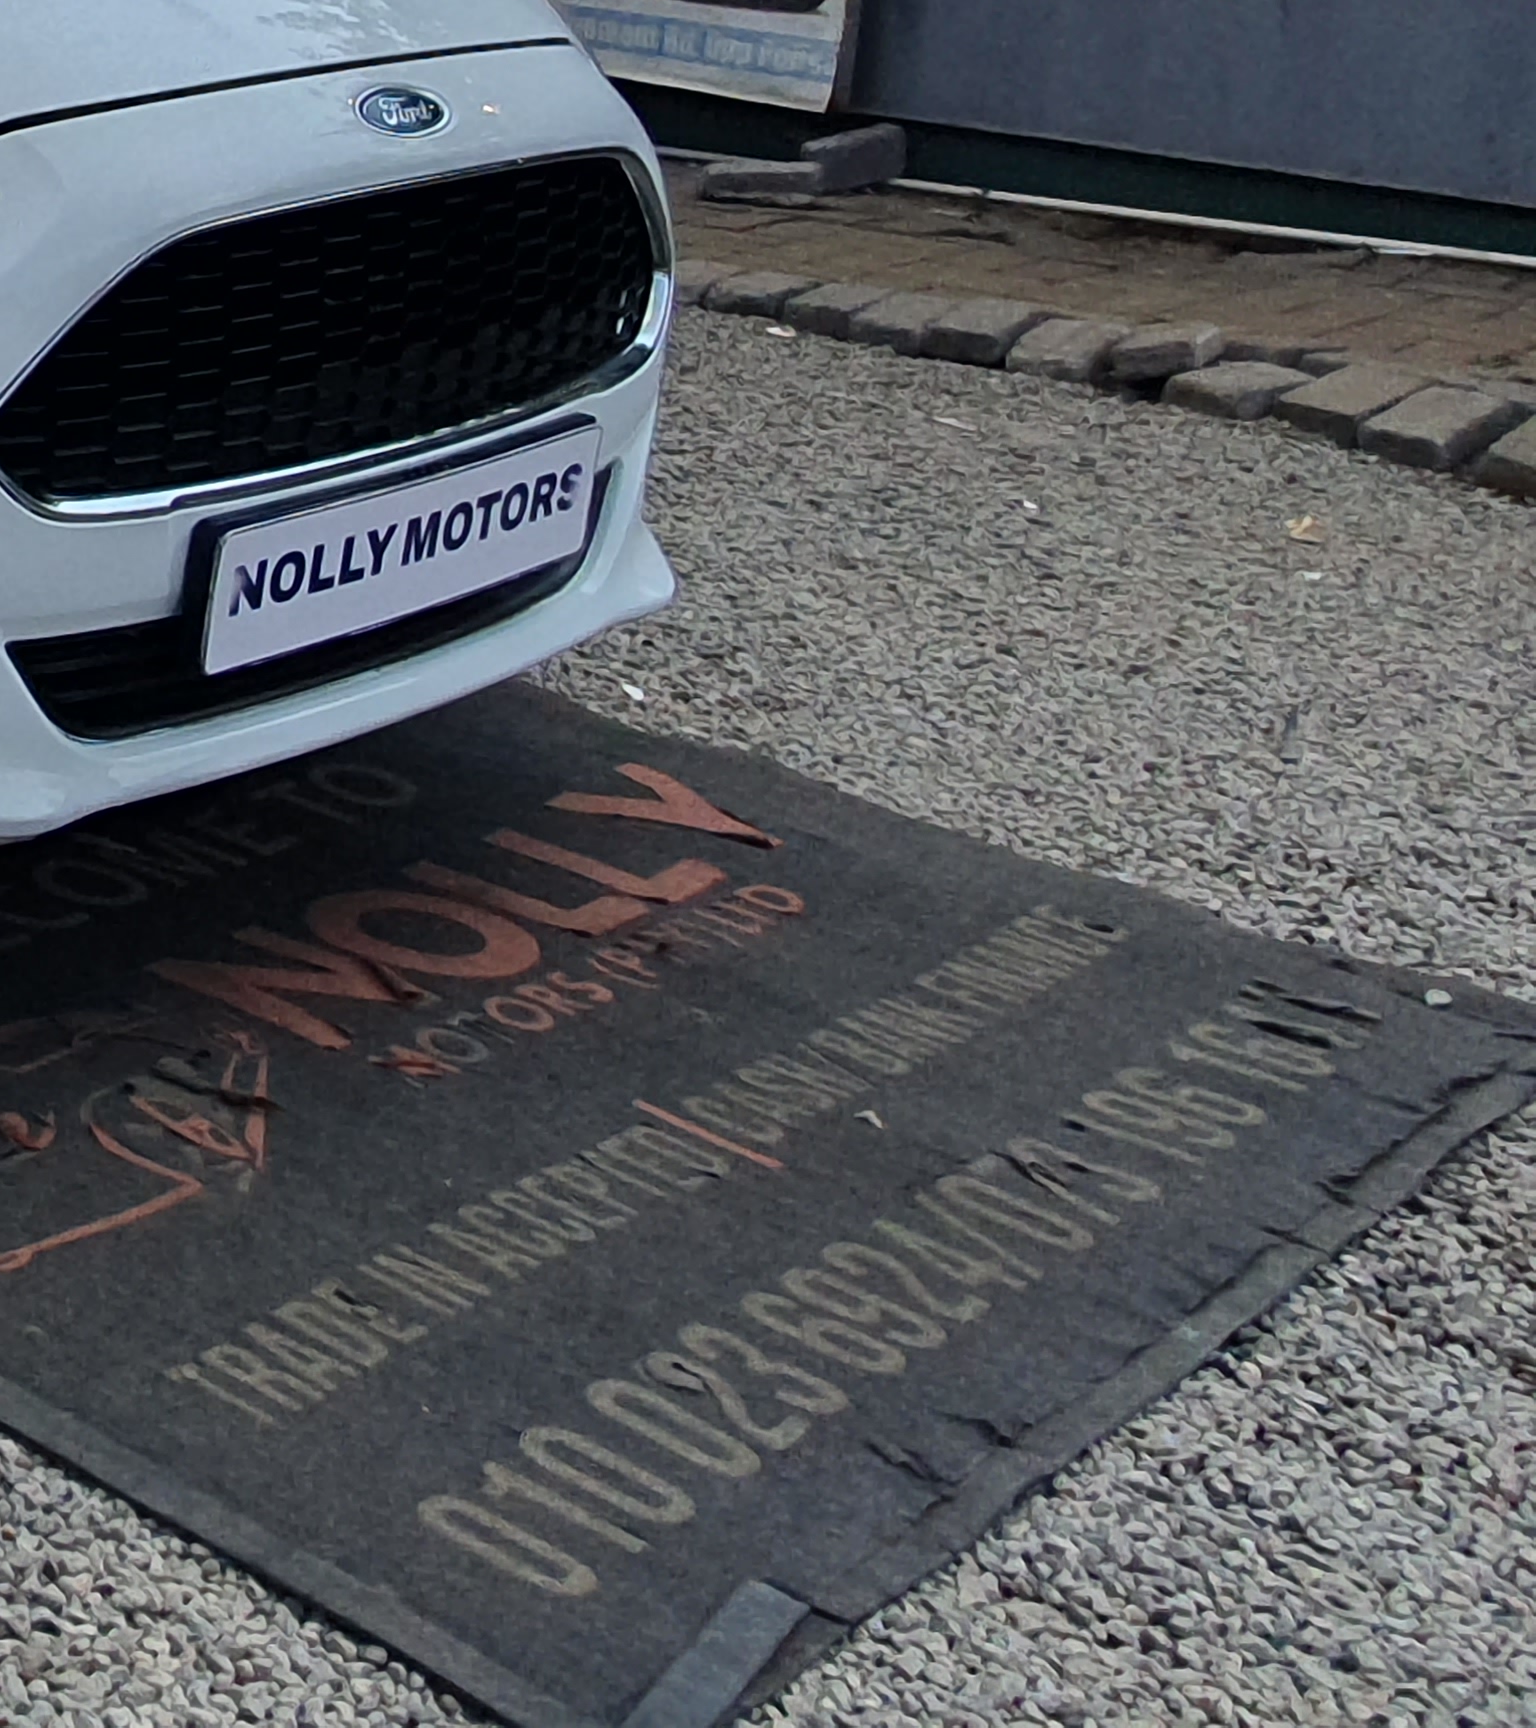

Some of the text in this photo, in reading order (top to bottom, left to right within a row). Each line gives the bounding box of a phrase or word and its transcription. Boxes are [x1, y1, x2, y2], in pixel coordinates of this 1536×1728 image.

[378, 96, 433, 126] Ford
[228, 463, 583, 617] NOLLY MOTORS
[255, 762, 417, 824] TO
[145, 761, 784, 1051] NOLLY
[367, 971, 615, 1087] MOTORS
[168, 1277, 429, 1428] TRADE
[356, 1244, 492, 1317] IN
[427, 1123, 729, 1279] ACCEPTED
[914, 904, 1128, 1015] FINANCE
[418, 1425, 696, 1597] 010
[585, 1322, 851, 1477] 023
